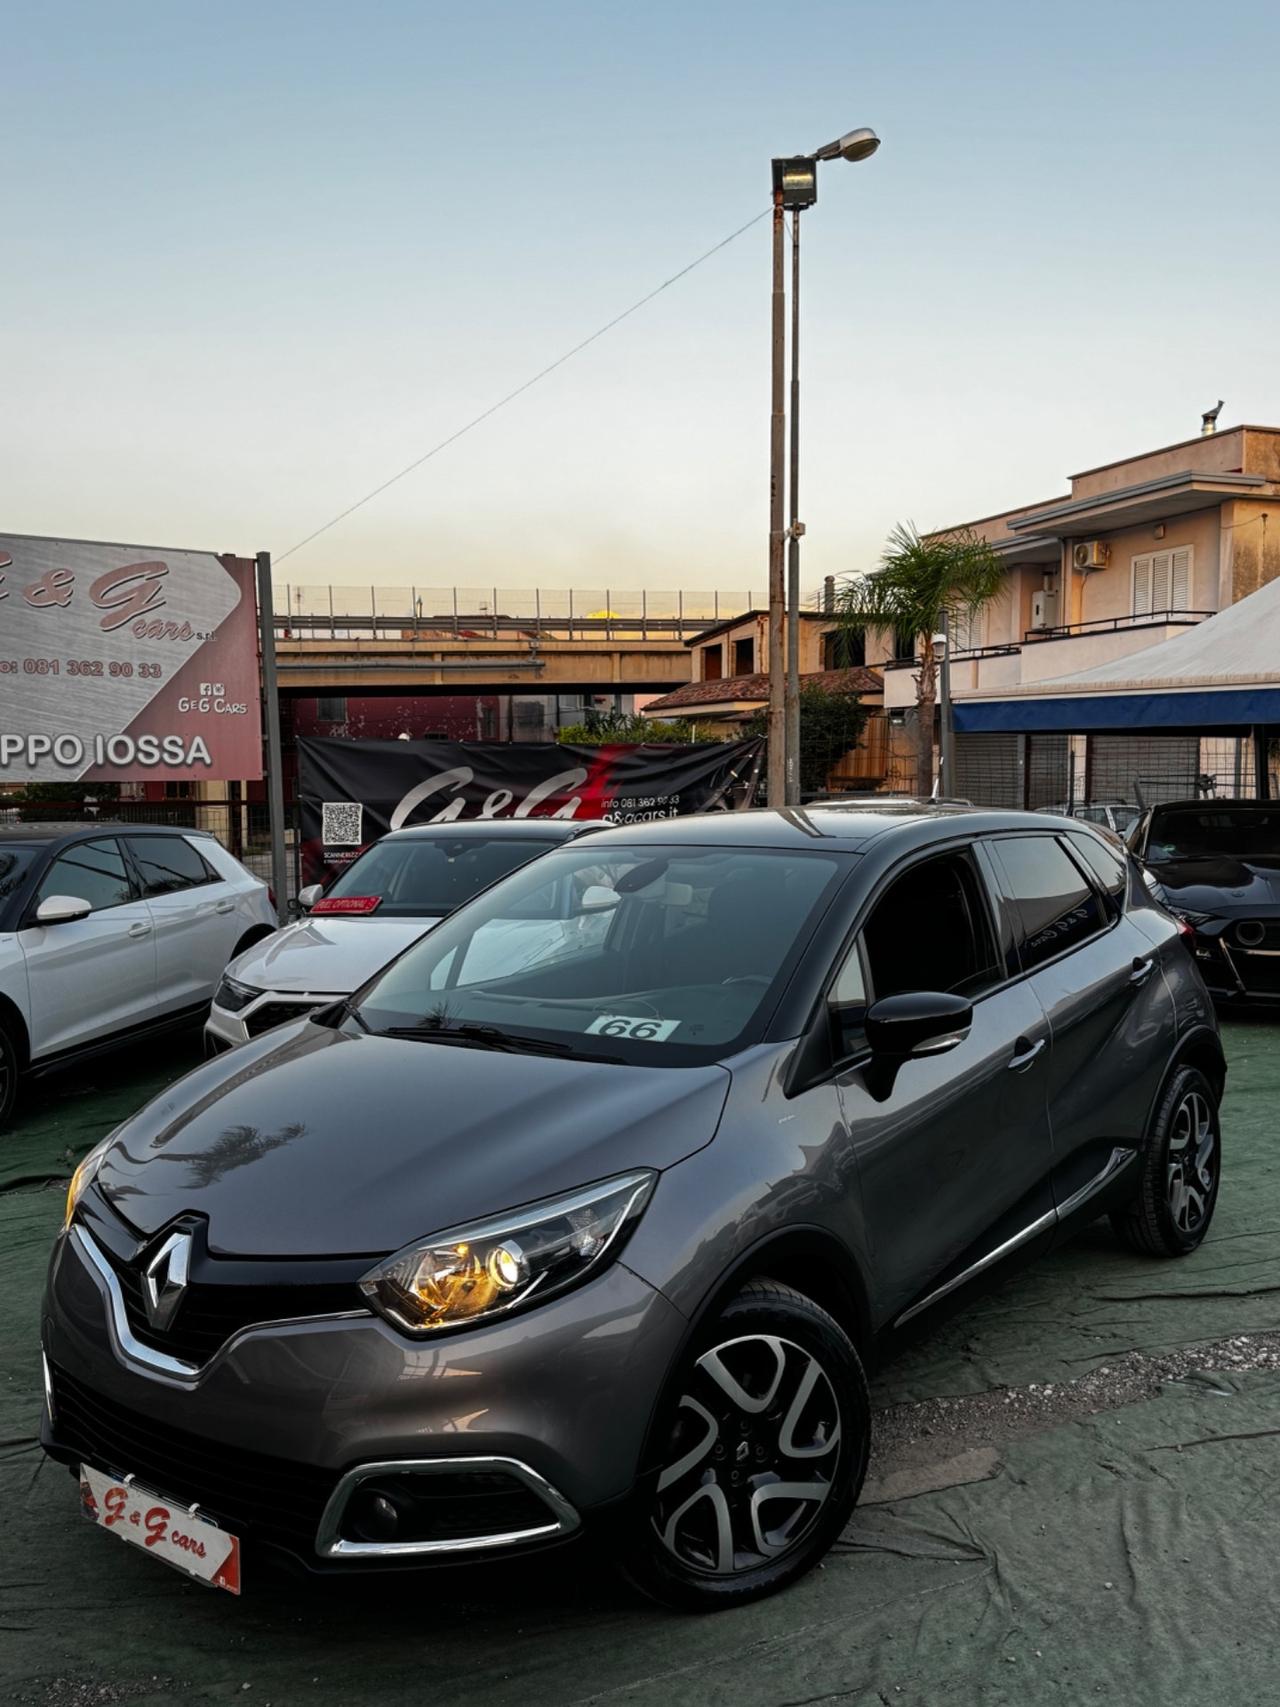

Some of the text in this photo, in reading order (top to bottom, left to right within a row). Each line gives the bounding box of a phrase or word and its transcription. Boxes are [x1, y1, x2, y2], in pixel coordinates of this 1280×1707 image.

[88, 560, 169, 632] G
[131, 616, 195, 642] cars
[23, 658, 60, 676] 081
[66, 659, 104, 677] 362
[109, 661, 133, 678] 90
[138, 663, 162, 678] 33
[0, 734, 212, 766] PPO IOSSA
[620, 798, 636, 808] 081
[638, 797, 656, 807] 362
[598, 1019, 662, 1039] 66
[104, 1487, 128, 1527] G
[144, 1506, 170, 1547] G
[171, 1529, 207, 1559] cars
